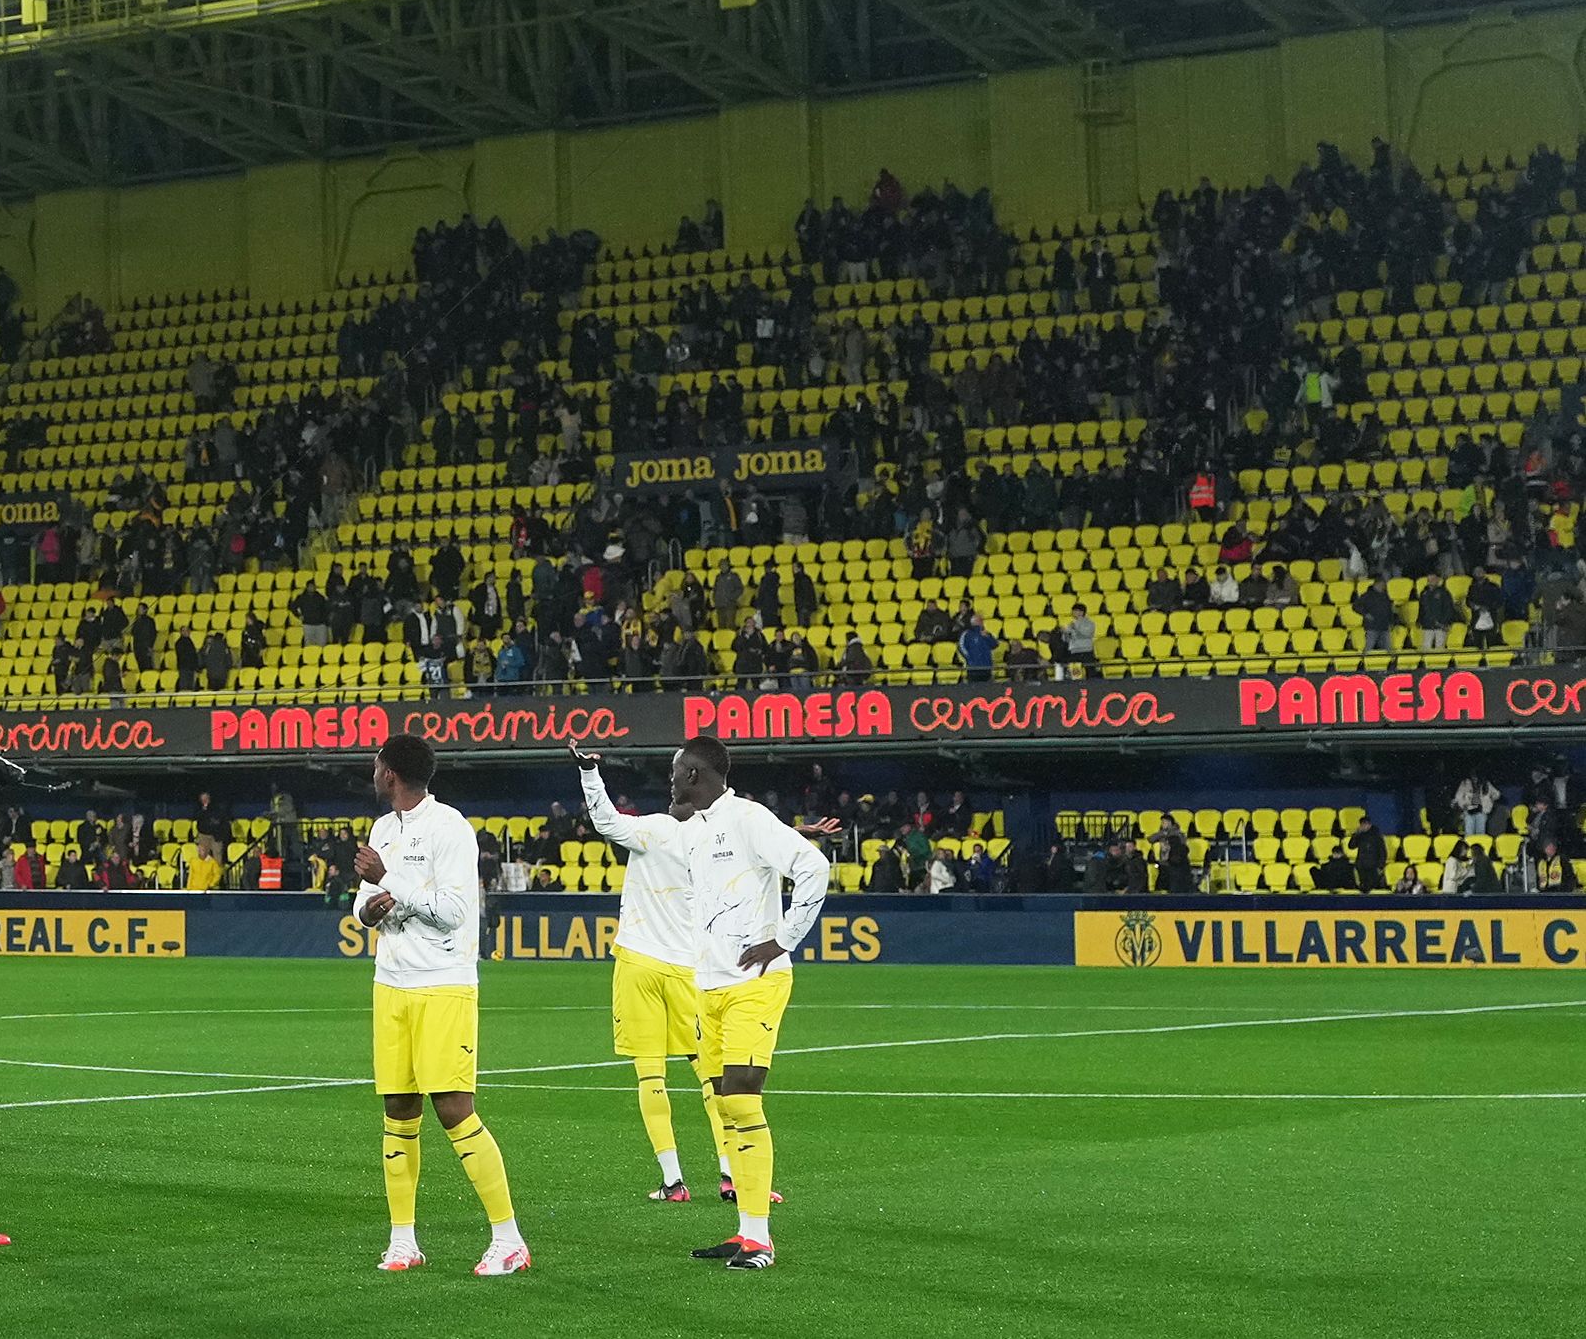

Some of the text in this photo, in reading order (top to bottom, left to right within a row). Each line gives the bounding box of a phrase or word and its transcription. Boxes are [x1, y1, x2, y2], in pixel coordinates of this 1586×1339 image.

[211, 705, 390, 750] PAMESA
[404, 703, 630, 743] cerámica
[684, 690, 893, 739] PAMESA
[910, 687, 1176, 732] cerámica
[1239, 671, 1485, 725] PAMESA
[87, 916, 156, 953] C.F.
[1174, 918, 1521, 964] VILLARREAL
